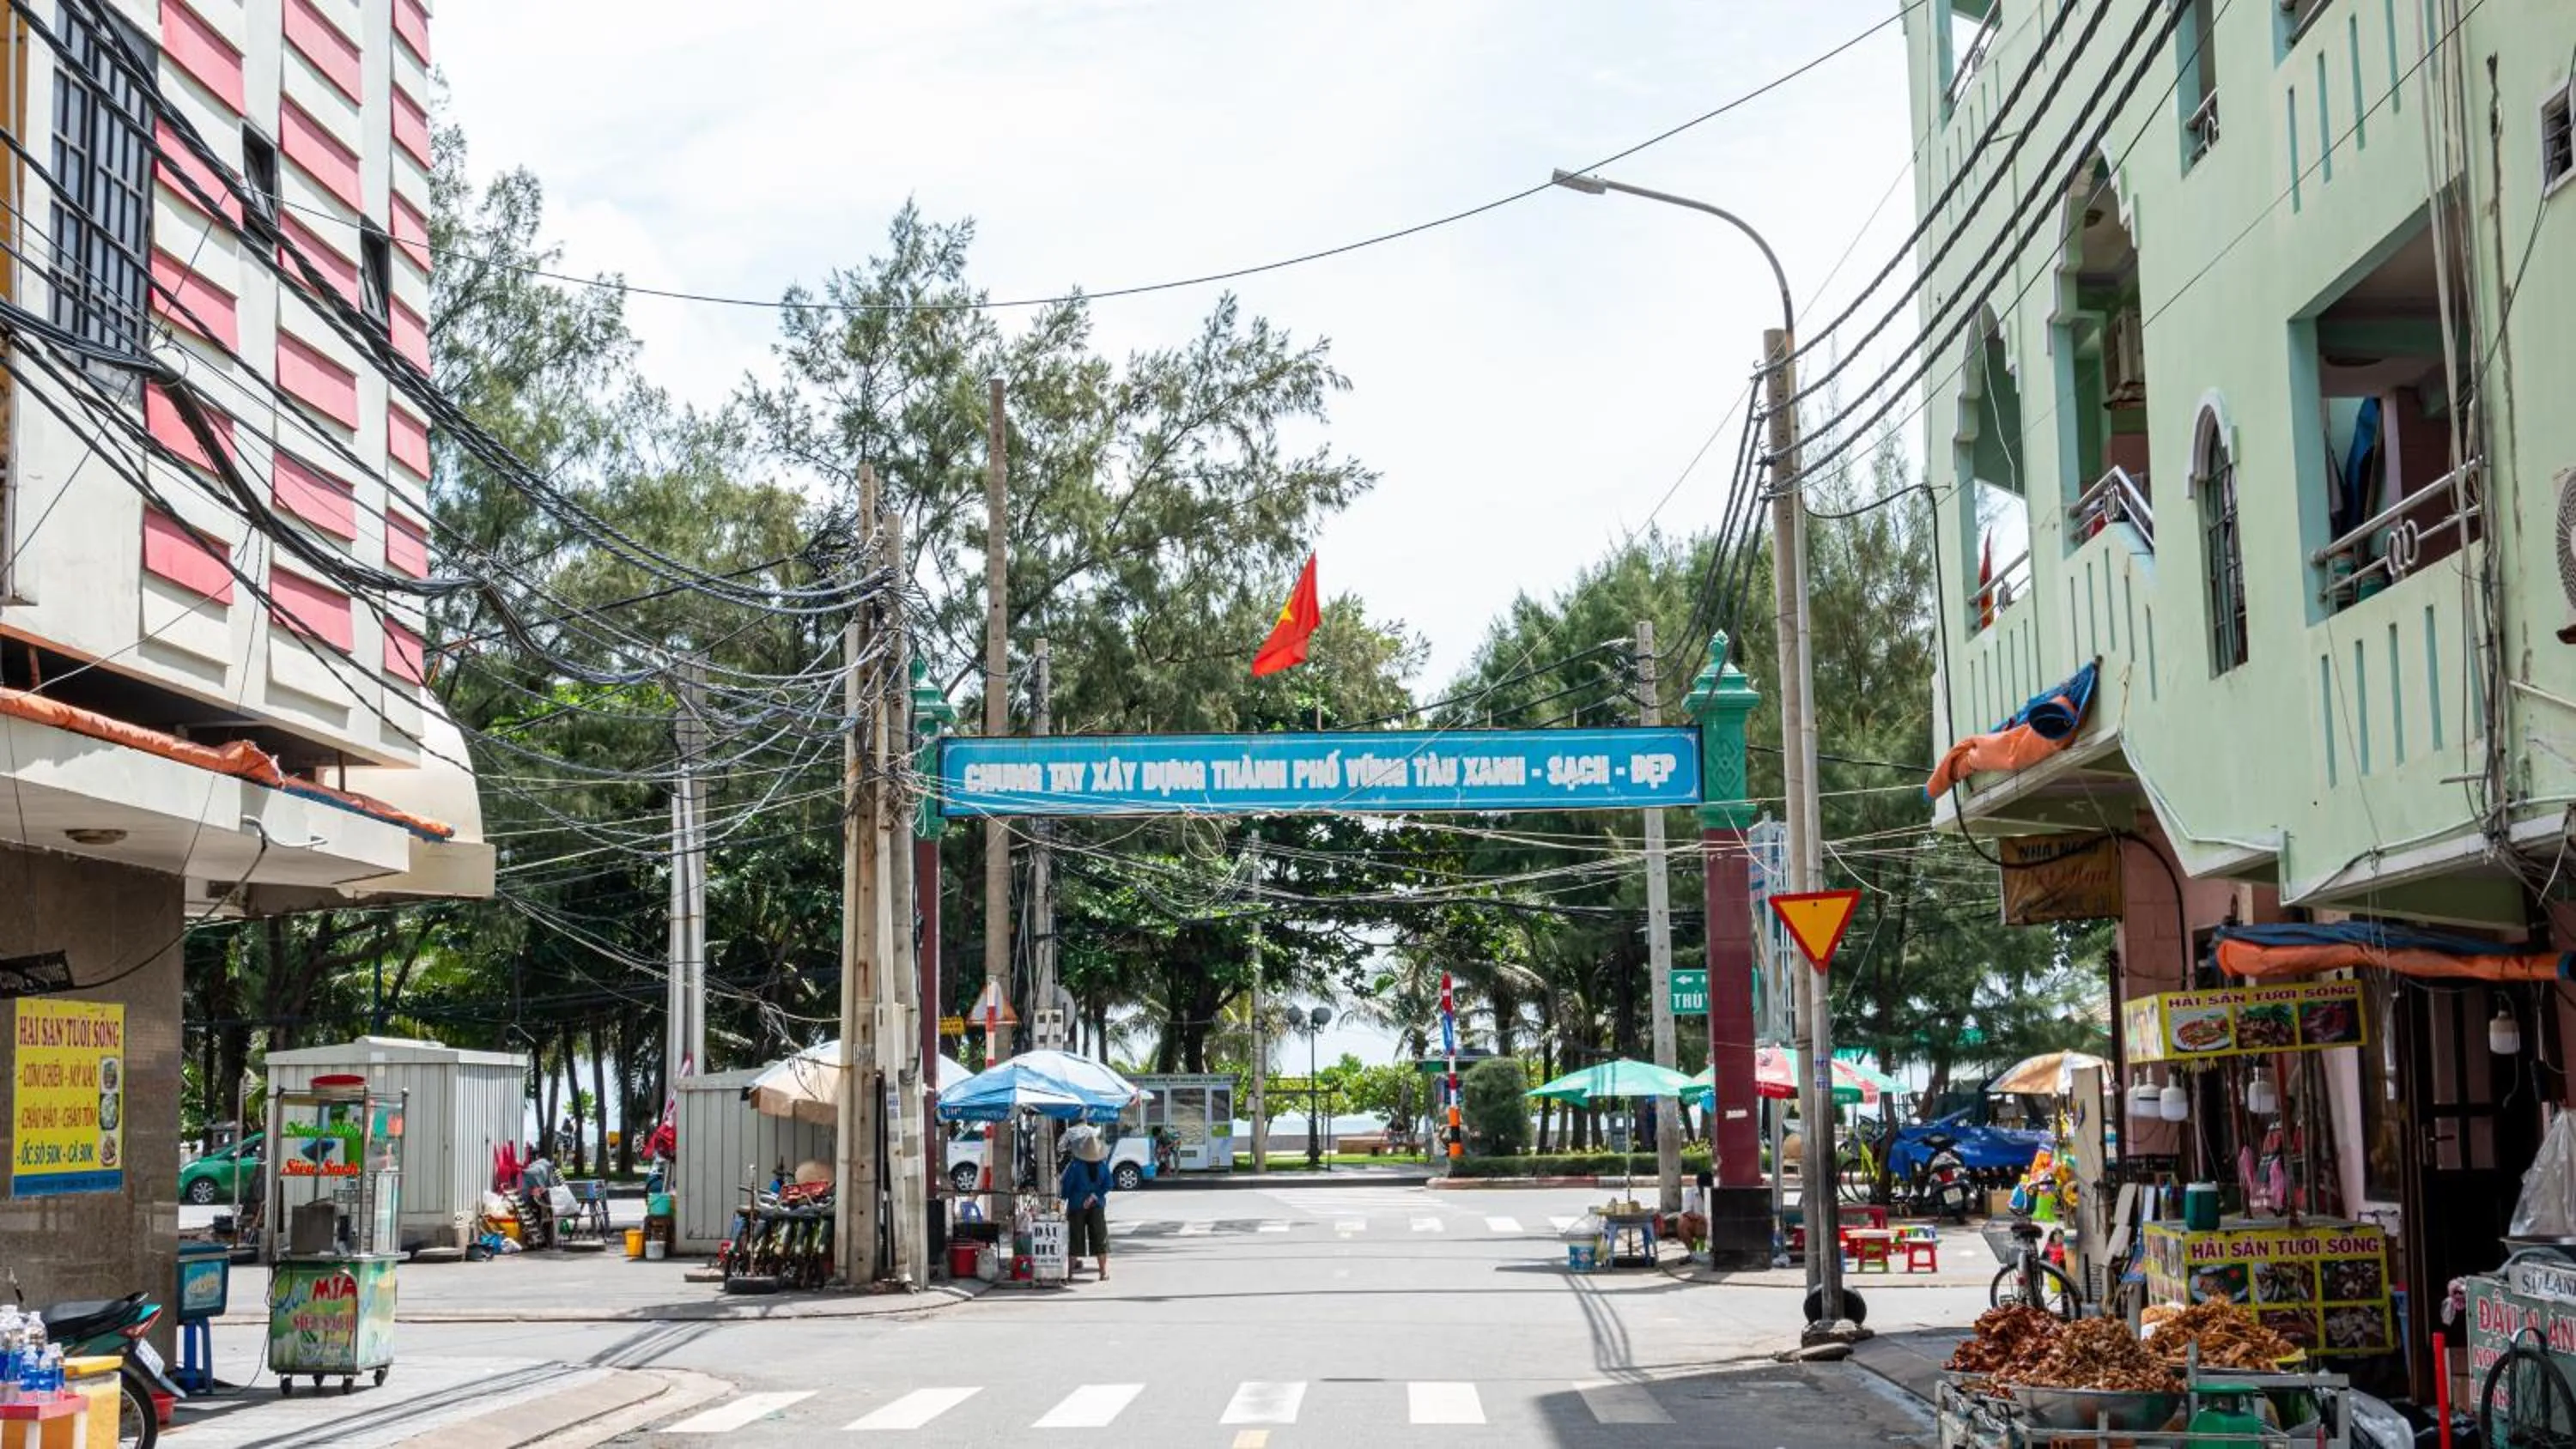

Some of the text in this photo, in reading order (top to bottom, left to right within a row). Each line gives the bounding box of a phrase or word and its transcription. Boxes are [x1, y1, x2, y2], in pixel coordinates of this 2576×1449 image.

[965, 762, 1042, 793] CHUNG
[1048, 762, 1086, 792] TAY
[1091, 755, 1137, 791] XÂY
[1211, 755, 1286, 790] THÀNH
[1293, 749, 1341, 789] PHỐ
[1413, 751, 1458, 788] TÀU
[1462, 755, 1526, 787] XANH
[1546, 755, 1610, 791] SẠCH
[2525, 1307, 2576, 1354] NÀN
